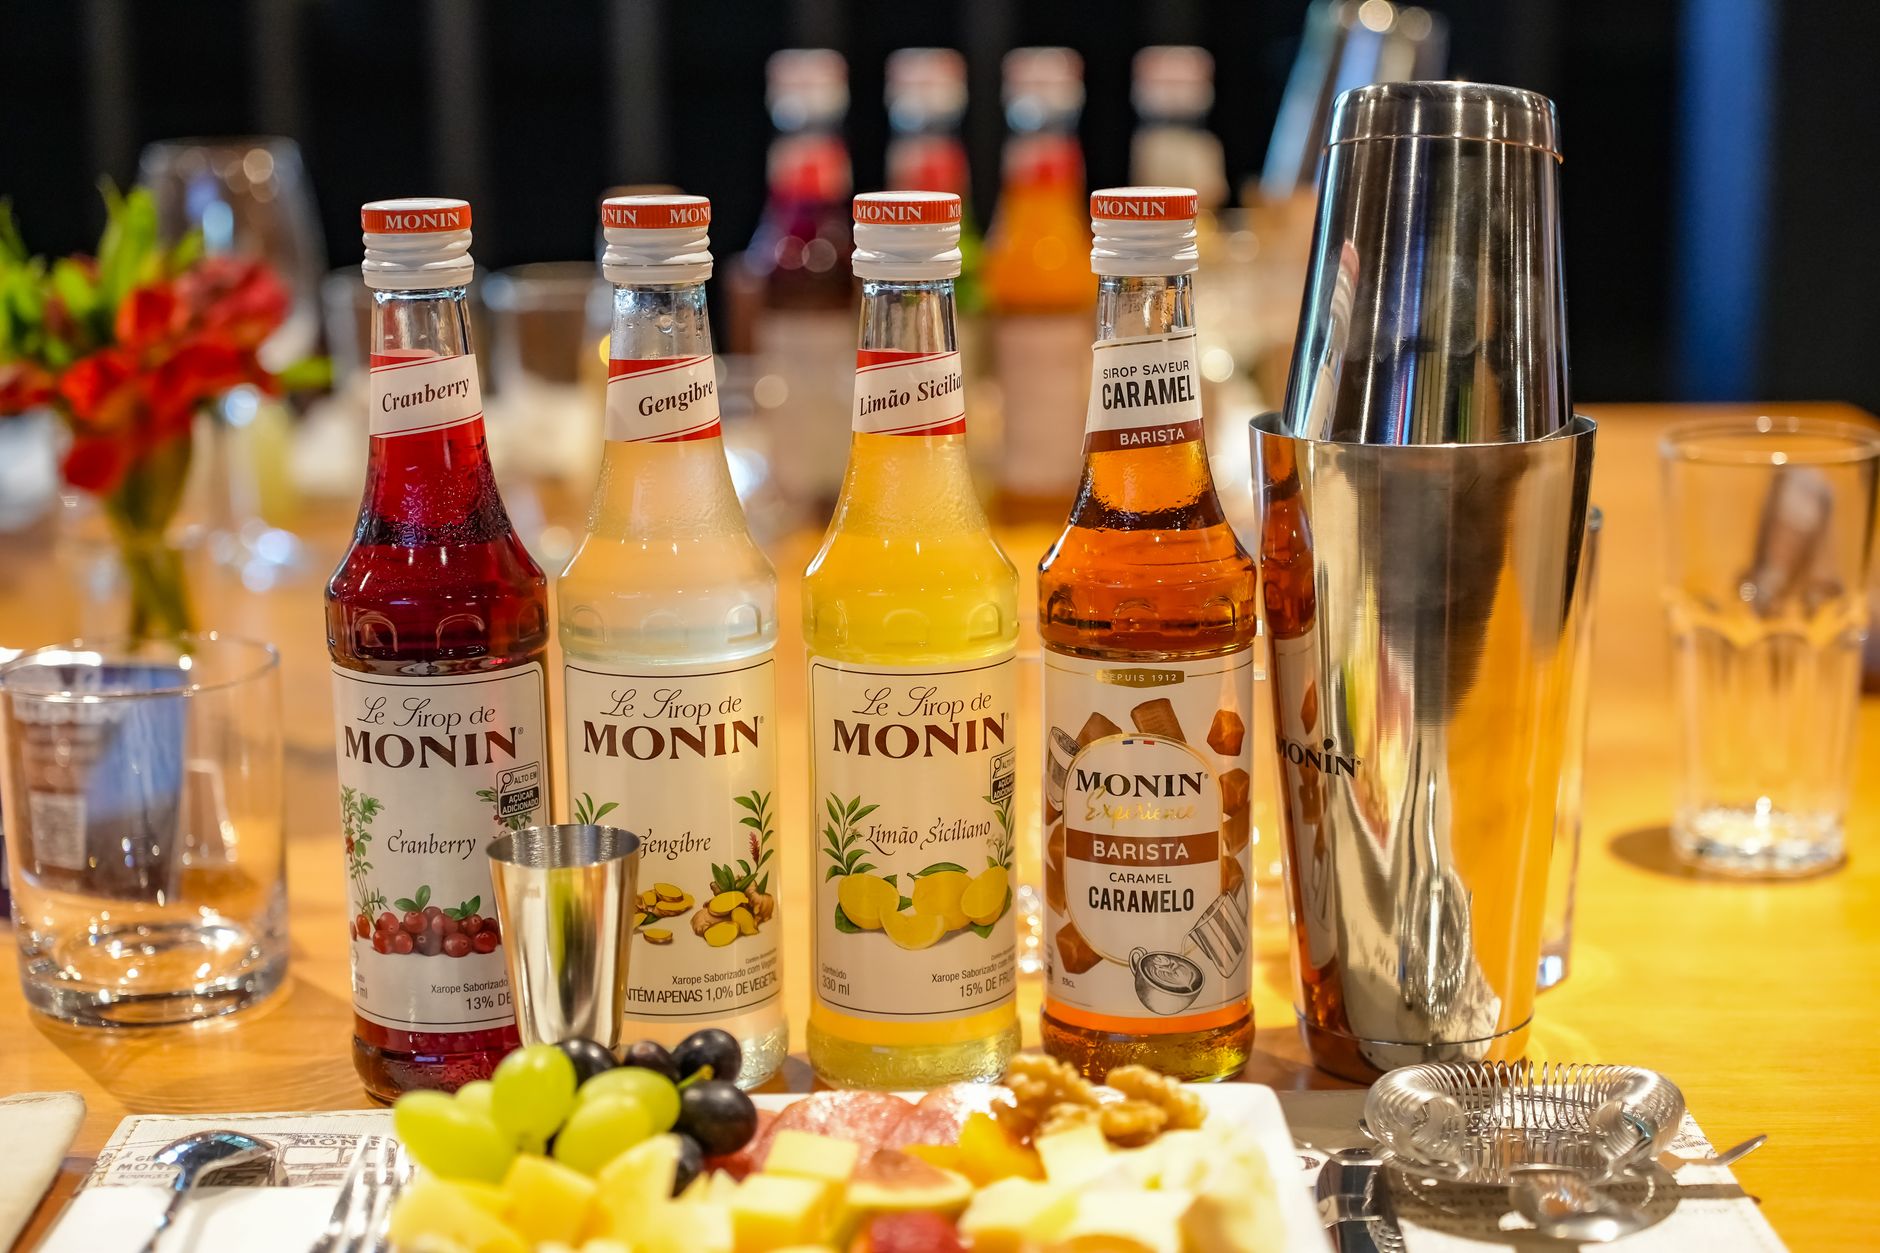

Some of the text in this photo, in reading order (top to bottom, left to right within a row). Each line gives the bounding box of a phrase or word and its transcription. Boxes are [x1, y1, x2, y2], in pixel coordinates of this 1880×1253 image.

[602, 209, 637, 224] ONIN
[856, 204, 922, 220] MONIN
[1096, 200, 1166, 216] MONIN
[385, 211, 460, 229] MONIN
[1103, 360, 1189, 379] SIROP SAVEUR
[382, 378, 469, 413] Cranberry
[638, 380, 713, 416] Gengibre
[860, 372, 963, 416] Limão Sicilia
[1102, 375, 1195, 410] CARAMEL
[1120, 428, 1185, 446] BARISTA
[1151, 674, 1177, 683] 1912
[600, 688, 742, 725] Le Sirop de
[852, 686, 992, 722] Le Sirop de
[357, 697, 496, 734] Le Sirop de
[513, 774, 528, 784] ALTO
[387, 829, 476, 860] Cranberry
[865, 817, 991, 856] Limão Siciliano
[1093, 840, 1189, 860] BARISTA
[1109, 872, 1172, 884] CARAMEL
[1088, 886, 1194, 913] CARAMELO
[431, 978, 508, 994] Xarope Saborizado
[672, 975, 701, 986] Xarope
[704, 968, 746, 983] Saborizado
[822, 975, 850, 996] 330 ml
[932, 972, 960, 983] Xarope
[627, 986, 654, 1002] NTÉM
[656, 988, 703, 1004] APENAS
[706, 985, 734, 1003] 1,0%
[736, 981, 749, 996] DE
[959, 982, 983, 998] 15%
[985, 978, 997, 992] DE
[466, 996, 494, 1010] 13%
